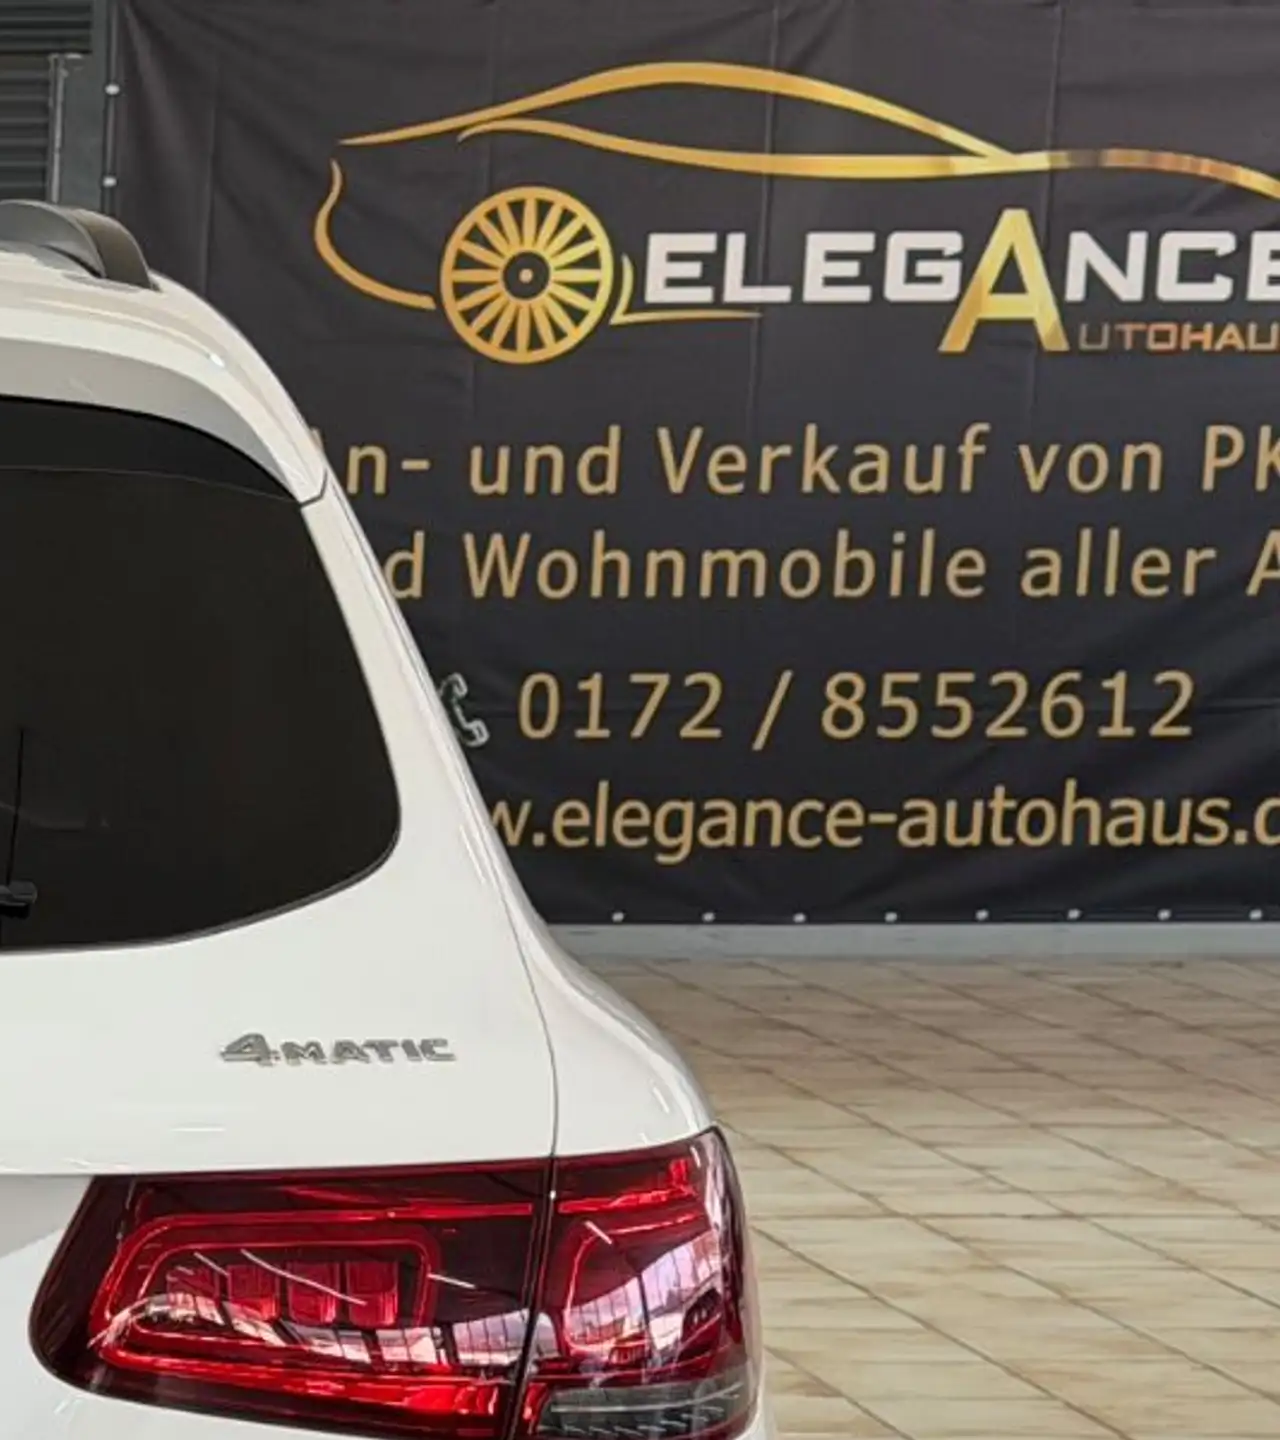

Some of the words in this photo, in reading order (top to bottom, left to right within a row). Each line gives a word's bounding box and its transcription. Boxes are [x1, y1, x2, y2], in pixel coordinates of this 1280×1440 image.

[318, 430, 430, 495] n-
[469, 426, 623, 495] und
[657, 422, 991, 496] Verkauf
[1018, 442, 1164, 494] von
[1201, 424, 1280, 493] PK
[462, 529, 988, 600] Wohnmobile
[1019, 528, 1217, 598] aller
[517, 672, 725, 740] 0172
[751, 669, 794, 750] /
[820, 670, 1196, 740] 8552612
[219, 1032, 457, 1067] 4MATIC
